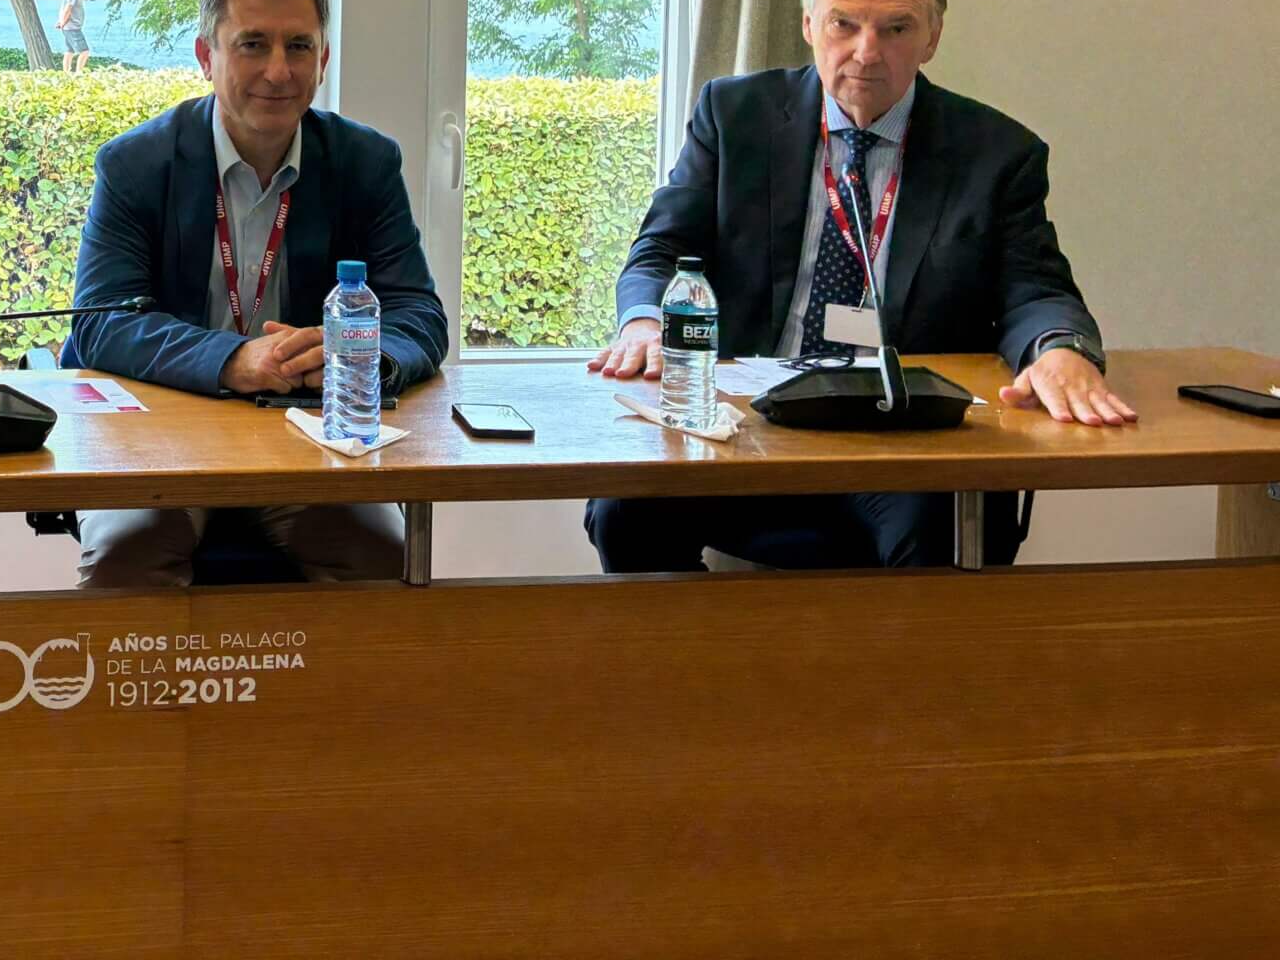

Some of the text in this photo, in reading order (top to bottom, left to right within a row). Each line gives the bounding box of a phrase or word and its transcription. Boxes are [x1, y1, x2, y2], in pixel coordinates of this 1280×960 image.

[828, 187, 840, 210] UIMP
[880, 192, 892, 215] UIMP
[276, 204, 287, 229] UIMP
[222, 241, 233, 267] UIMP
[263, 250, 274, 276] UIMP
[229, 290, 240, 316] UIMP
[108, 631, 307, 653] AÑOS DEL PALACIO
[106, 653, 306, 675] DE LA MAGDALENA
